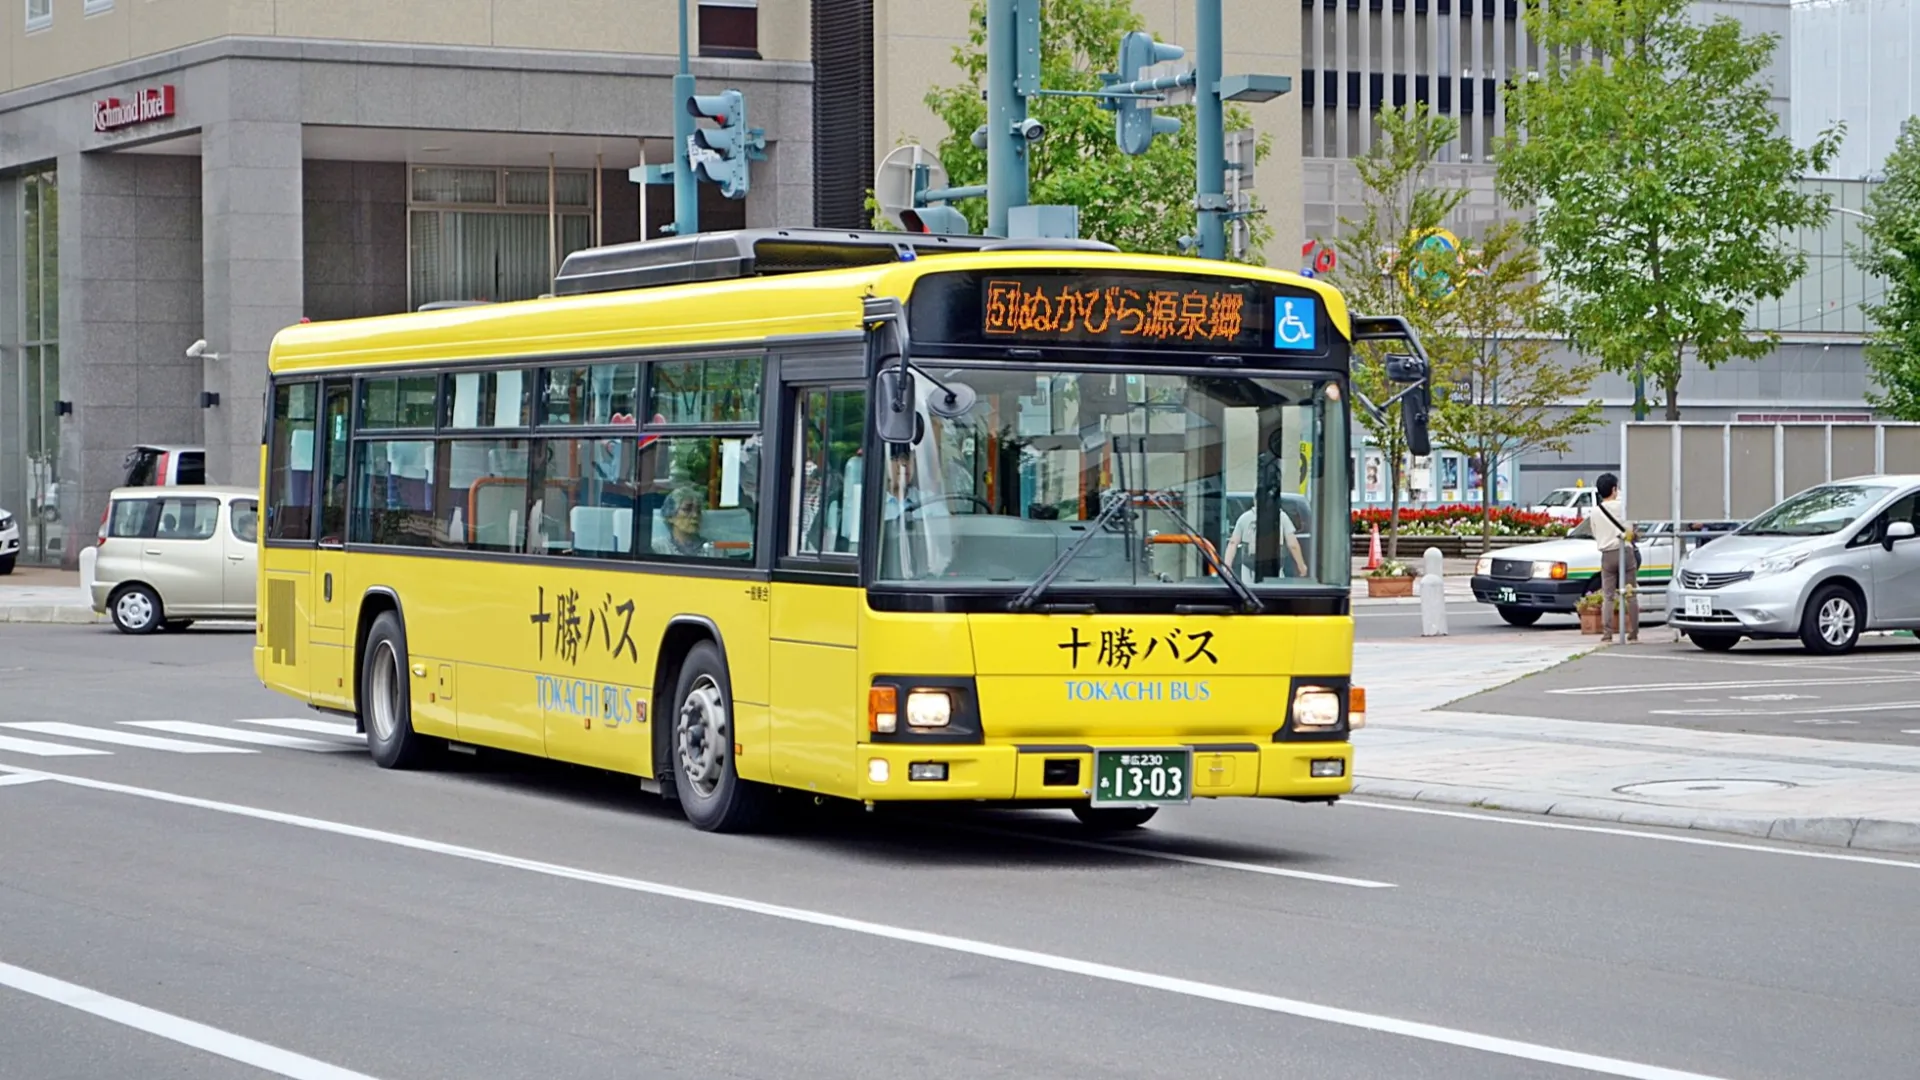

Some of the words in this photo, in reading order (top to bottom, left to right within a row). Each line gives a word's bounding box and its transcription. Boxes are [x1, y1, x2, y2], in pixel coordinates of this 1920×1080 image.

[93, 91, 139, 131] Richmond
[140, 86, 164, 122] Hotel
[990, 288, 1017, 327] 51
[1018, 285, 1243, 341] ぬかびら源泉郷
[530, 585, 638, 667] 十勝バス
[1057, 627, 1218, 670] 十勝バス
[535, 675, 599, 718] TOKACHI
[603, 685, 633, 724] BUS
[1064, 681, 1162, 701] TOKACHI
[1170, 681, 1210, 701] BUS
[1115, 767, 1182, 797] 13-03
